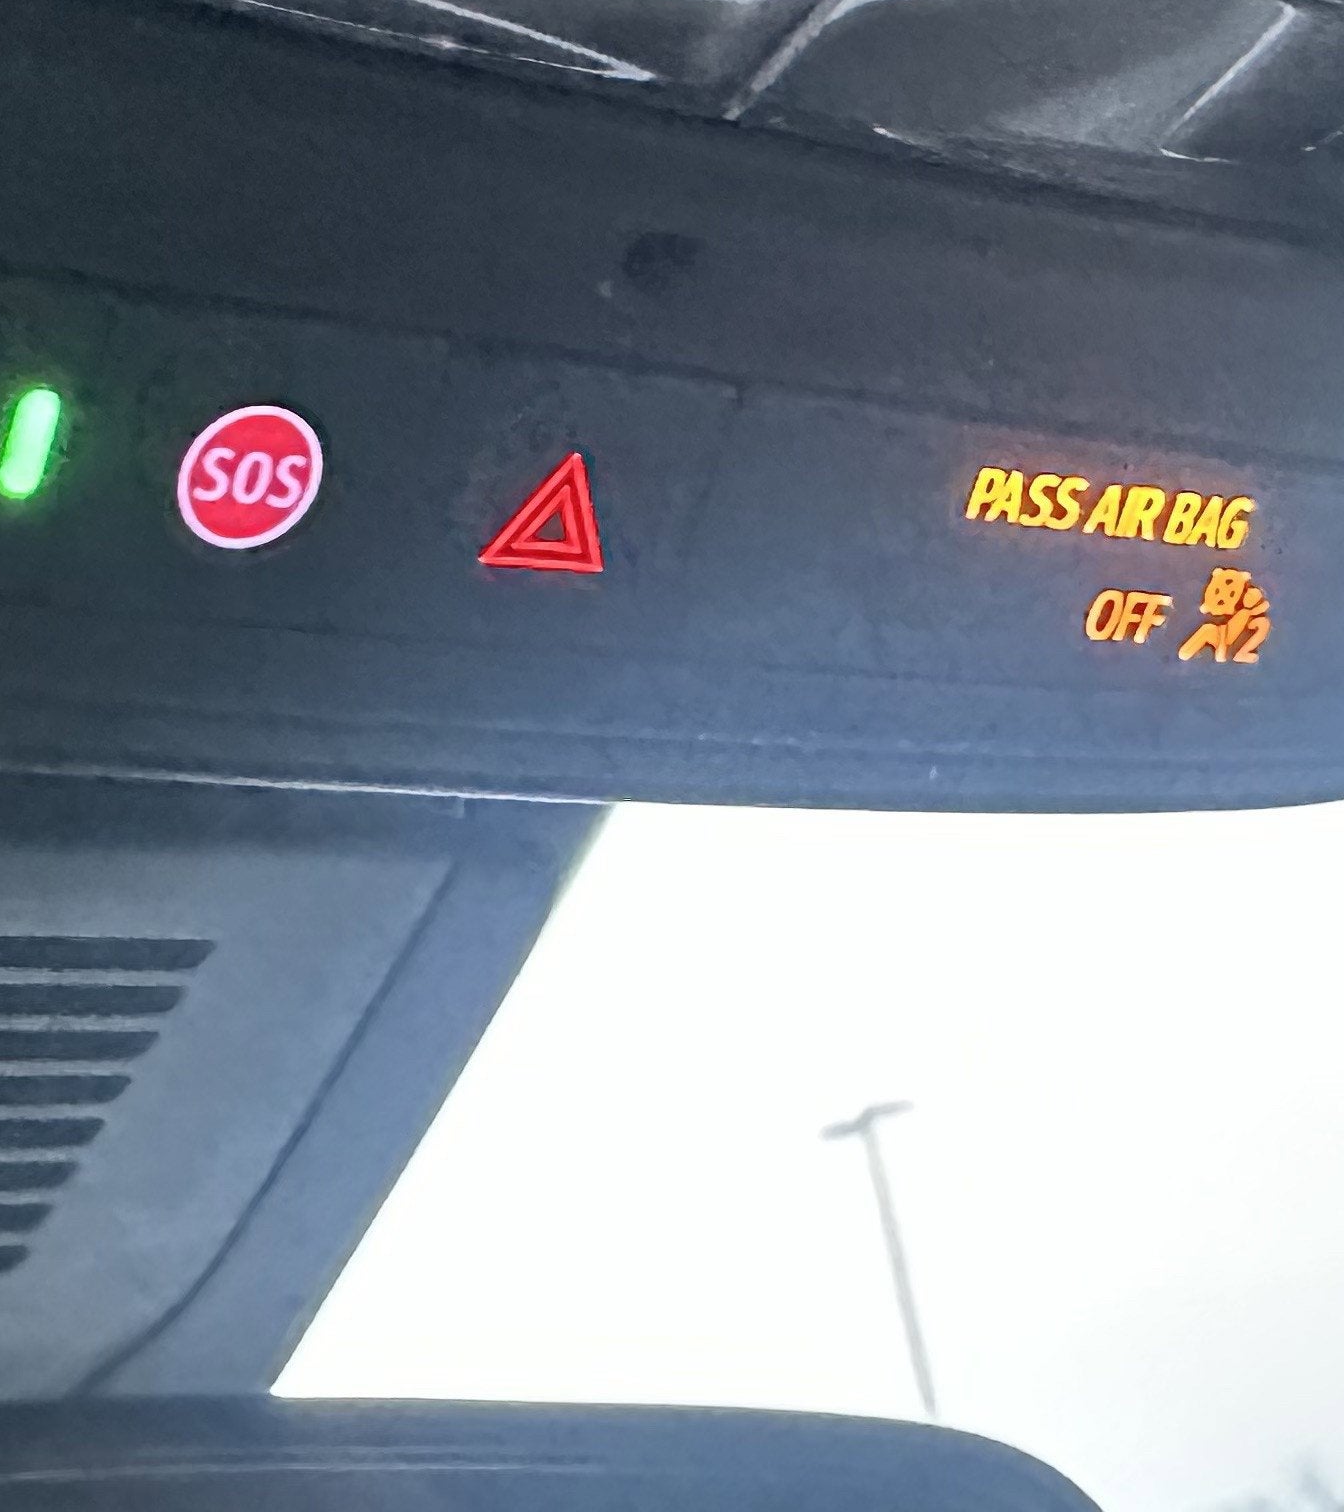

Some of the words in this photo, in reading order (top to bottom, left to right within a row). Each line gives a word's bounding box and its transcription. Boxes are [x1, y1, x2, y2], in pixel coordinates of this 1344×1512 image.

[192, 447, 308, 508] SOS
[965, 467, 1090, 530] PASS
[1163, 492, 1256, 549] BAG
[1086, 590, 1173, 643] OFF
